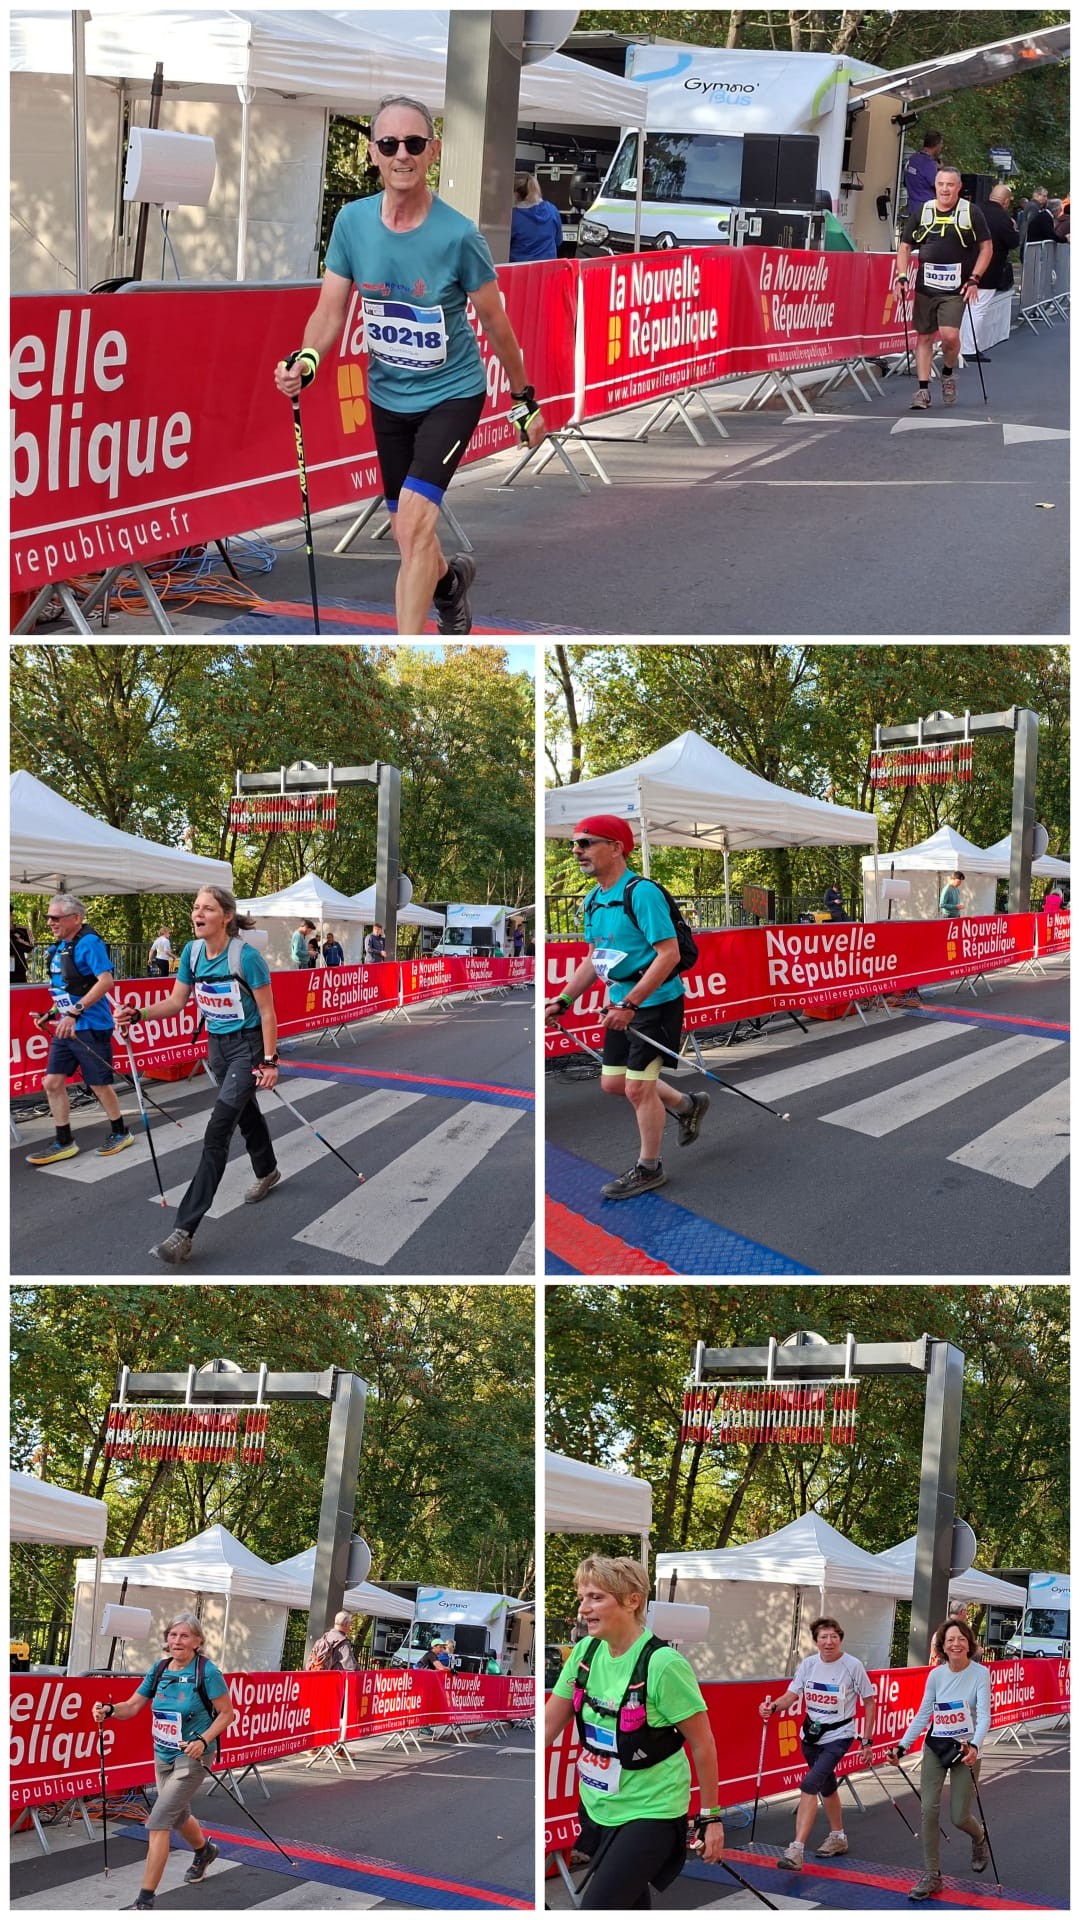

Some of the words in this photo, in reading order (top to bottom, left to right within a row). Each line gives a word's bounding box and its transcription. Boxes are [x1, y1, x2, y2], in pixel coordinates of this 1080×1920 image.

[609, 263, 626, 312] la
[630, 255, 700, 307] Nouvelle
[759, 252, 773, 290] la
[773, 254, 829, 292] Nouvelle
[925, 271, 956, 281] 30370
[772, 293, 835, 338] République
[367, 322, 442, 349] 30218
[628, 301, 718, 362] République
[607, 363, 716, 403] www.lanouvellerepublique.fr
[15, 507, 190, 576] republique.fr
[947, 922, 959, 940] la
[961, 917, 1008, 938] Nouvelle
[765, 927, 876, 958] Nouvelle
[962, 935, 1016, 958] République
[308, 972, 320, 991] la
[322, 966, 369, 988] Nouvelle
[768, 952, 898, 988] République
[197, 993, 233, 1008] 30174
[322, 985, 379, 1010] République
[773, 980, 898, 1007] lanouvellerepublique.fr
[362, 1673, 371, 1694] la
[373, 1671, 413, 1691] Nouvelle
[1058, 1660, 1065, 1678] la
[229, 1675, 300, 1706] Nouvelle
[806, 1692, 838, 1705] 30225
[371, 1693, 421, 1717] République
[226, 1703, 311, 1741] République
